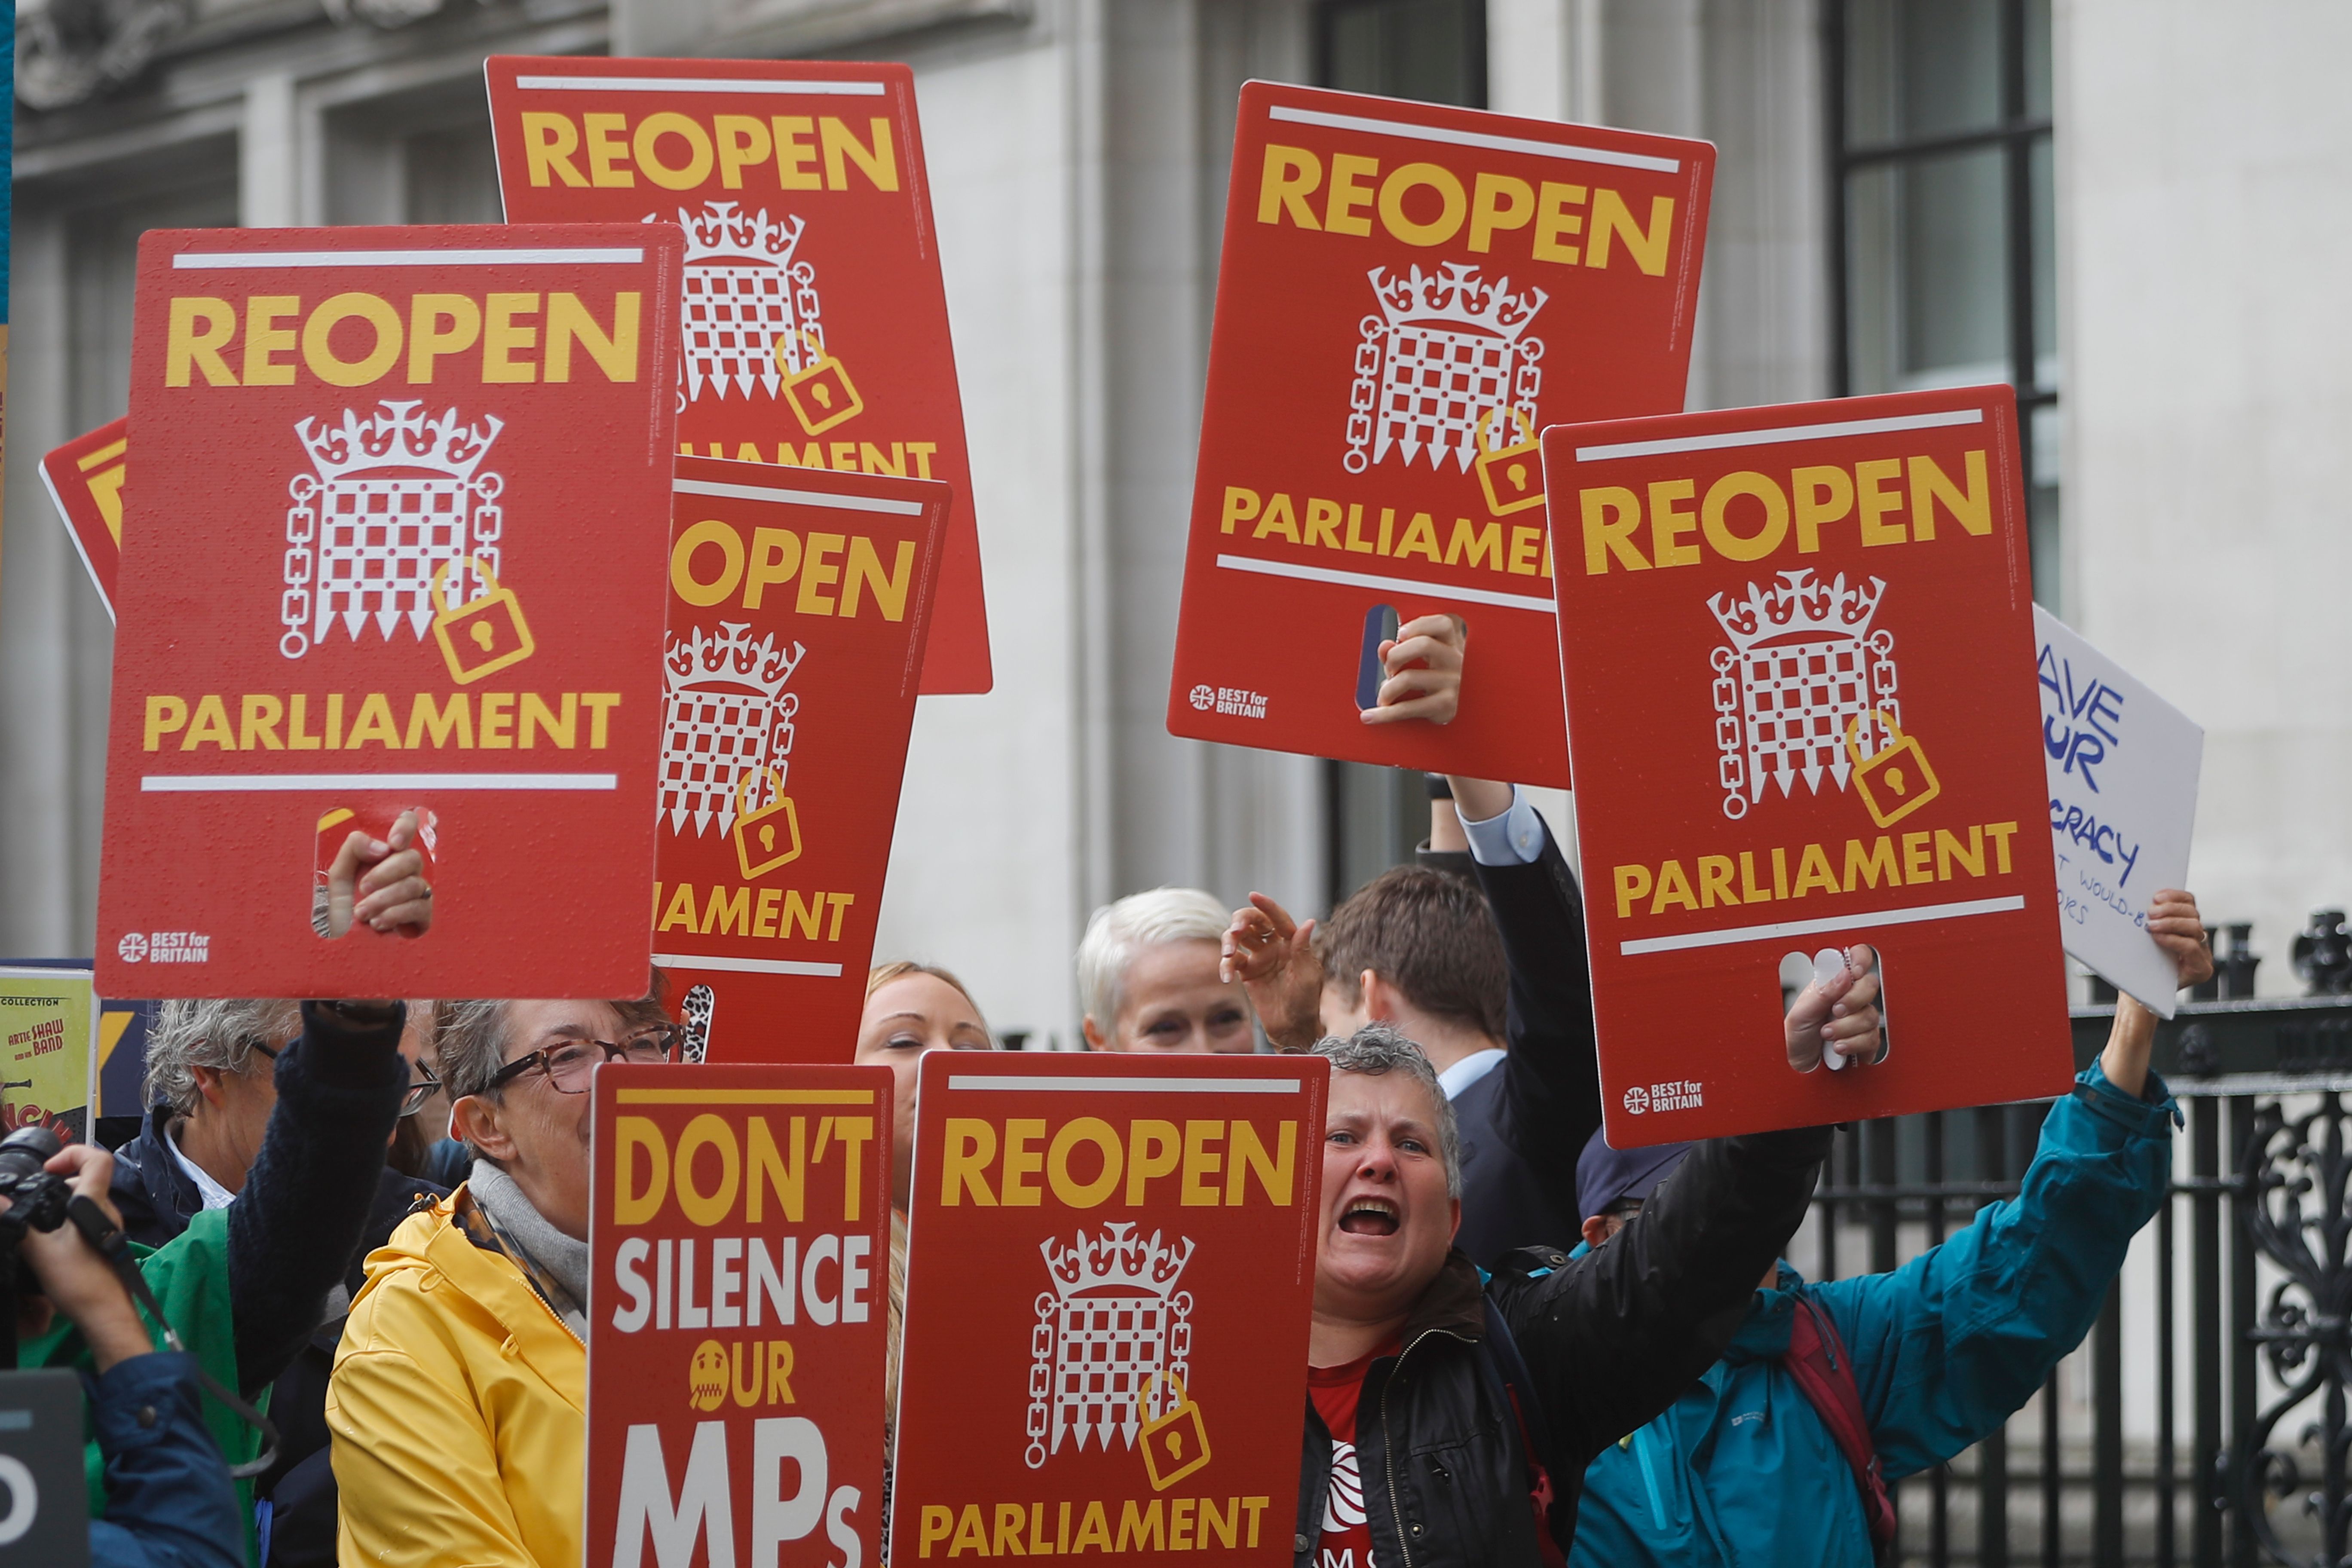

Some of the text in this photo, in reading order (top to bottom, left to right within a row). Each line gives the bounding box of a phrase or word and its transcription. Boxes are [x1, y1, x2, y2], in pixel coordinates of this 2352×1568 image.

[521, 111, 900, 192] REOPEN
[1257, 144, 1675, 277] REOPEN
[165, 291, 642, 387] REOPEN
[1220, 485, 1552, 578] PARLIAME
[1579, 449, 1994, 575] REOPEN
[669, 519, 916, 622] OPEN
[142, 692, 622, 751] PARLIAMENT
[1216, 700, 1266, 719] BRITAIN
[1218, 687, 1268, 706] BEST for
[2037, 643, 2123, 747] AVE
[2044, 714, 2104, 794] UR
[1613, 821, 2018, 918] PARLIAMENT
[2049, 799, 2139, 888] CRACY
[150, 947, 208, 963] BRITAIN
[151, 931, 210, 947] BEST for
[8, 1018, 64, 1046] ARTIE SHAW
[33, 1035, 63, 1056] BAND
[1651, 1079, 1702, 1098] BEST for
[1652, 1093, 1703, 1112] BRITAIN
[614, 1113, 873, 1227] DON'T
[940, 1116, 1298, 1209] REOPEN
[612, 1234, 870, 1333] SILENCE
[919, 1496, 1270, 1558] PARLIAMENT
